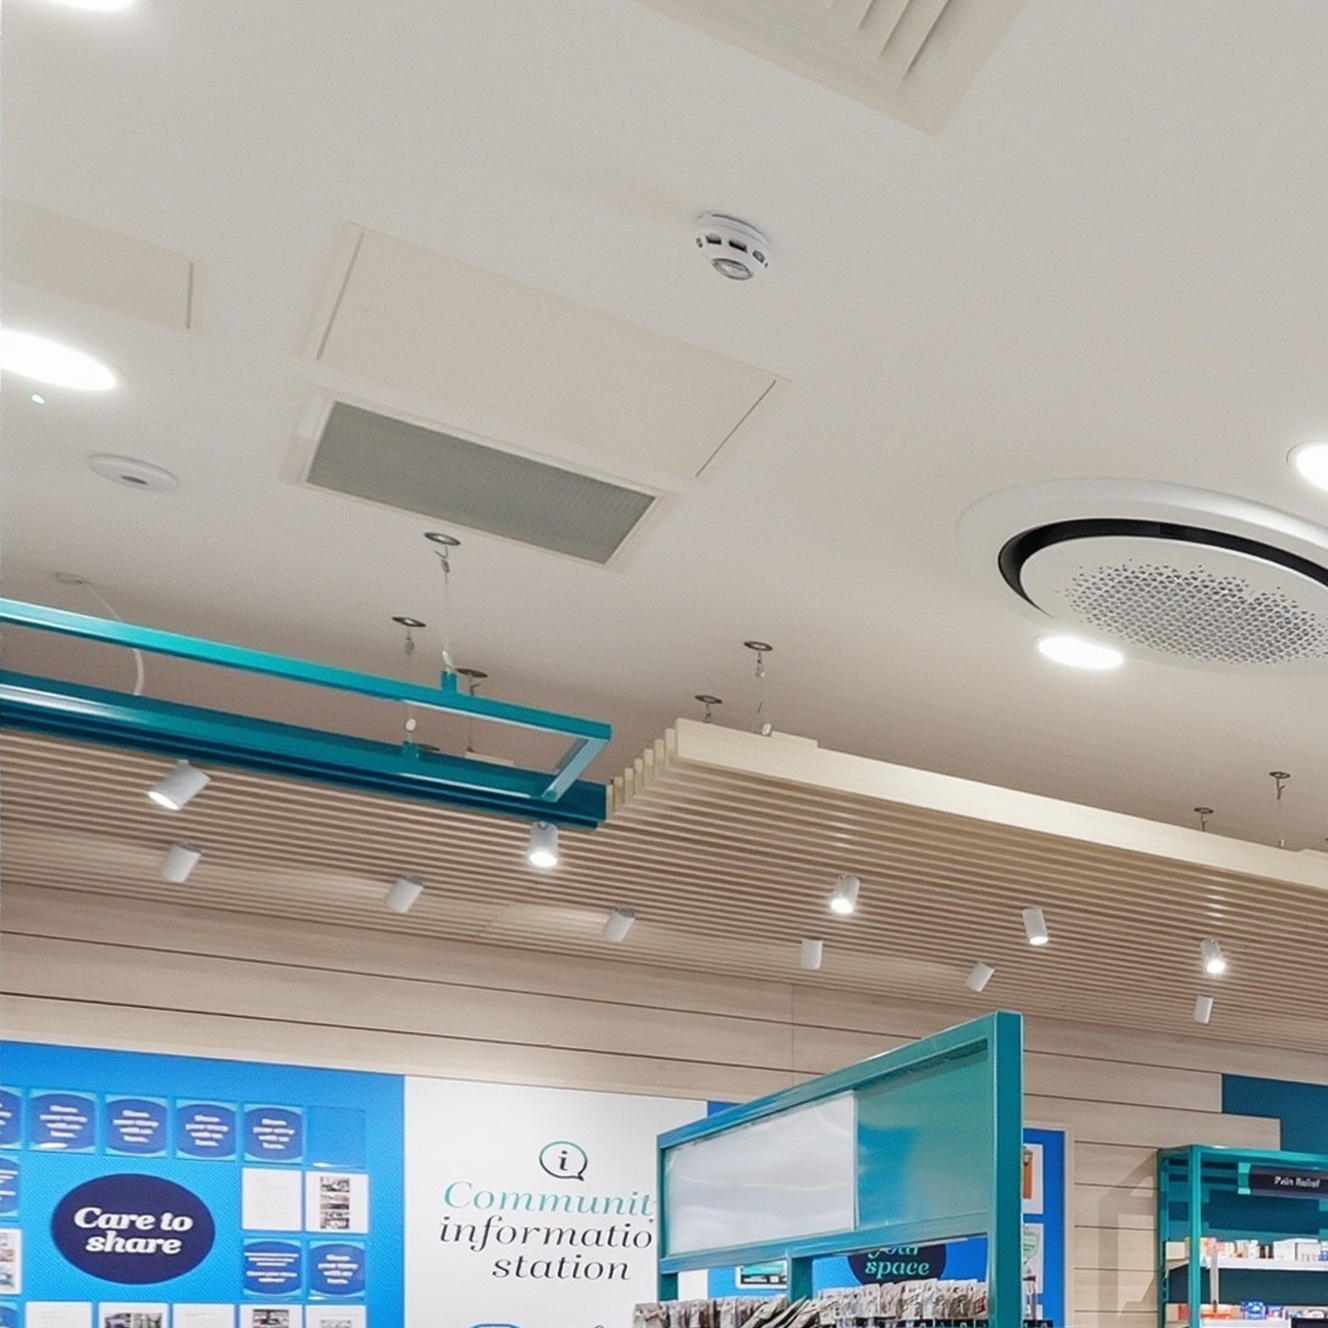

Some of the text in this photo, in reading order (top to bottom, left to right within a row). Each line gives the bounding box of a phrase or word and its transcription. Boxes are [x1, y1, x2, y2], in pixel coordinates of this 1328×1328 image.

[444, 1181, 654, 1223] Communit
[74, 1206, 194, 1232] Care to
[85, 1231, 182, 1254] share
[440, 1215, 653, 1252] informatio
[492, 1254, 631, 1280] station
[865, 1261, 930, 1279] space
